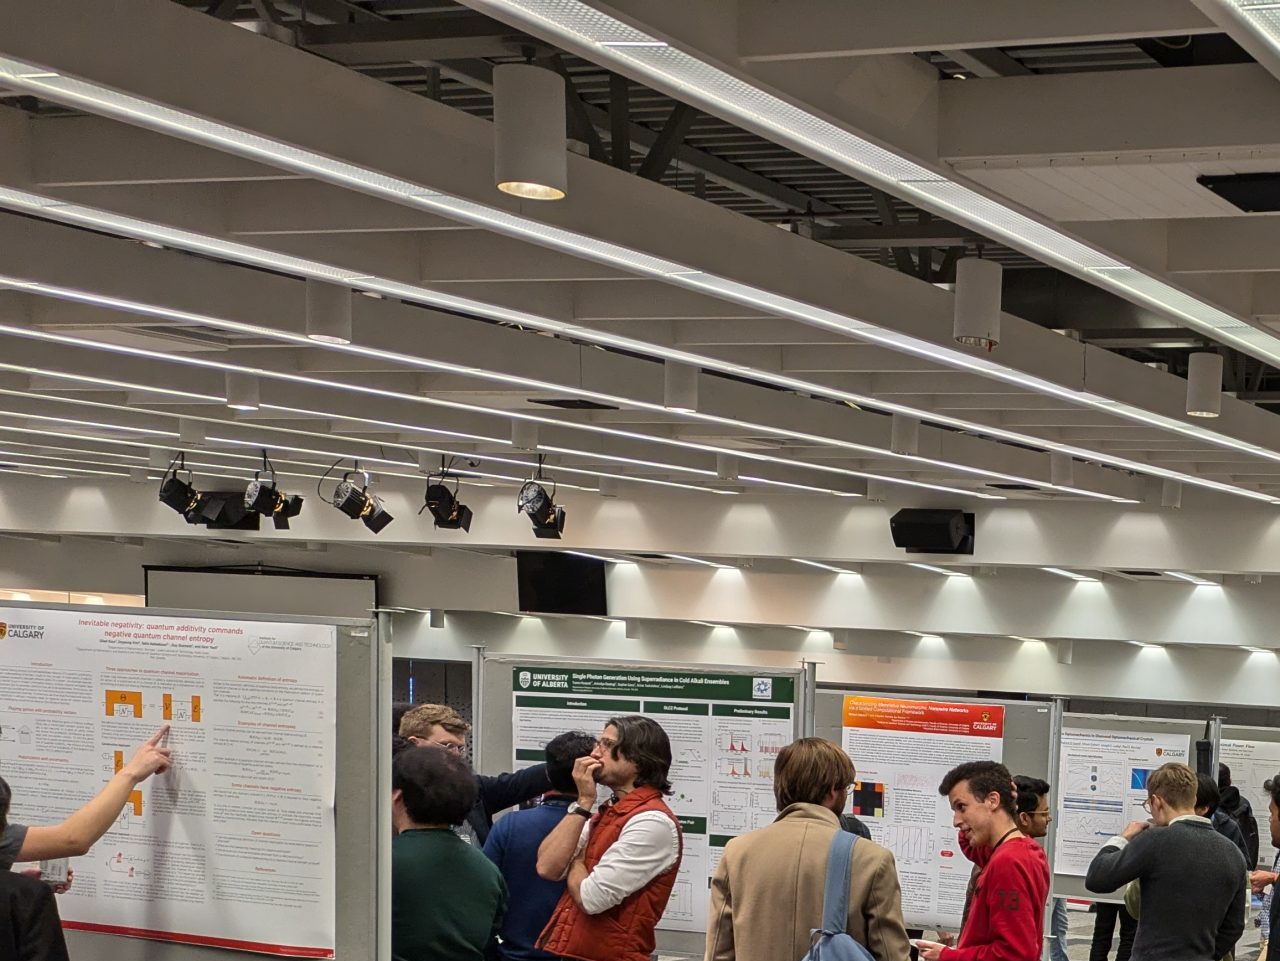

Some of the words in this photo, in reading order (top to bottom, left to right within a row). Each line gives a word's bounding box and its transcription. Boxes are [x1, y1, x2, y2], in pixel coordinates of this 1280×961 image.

[146, 622, 174, 632] quantum
[176, 624, 205, 633] additivity
[105, 629, 131, 638] negative
[133, 631, 161, 640] quantum
[189, 634, 214, 644] entropy
